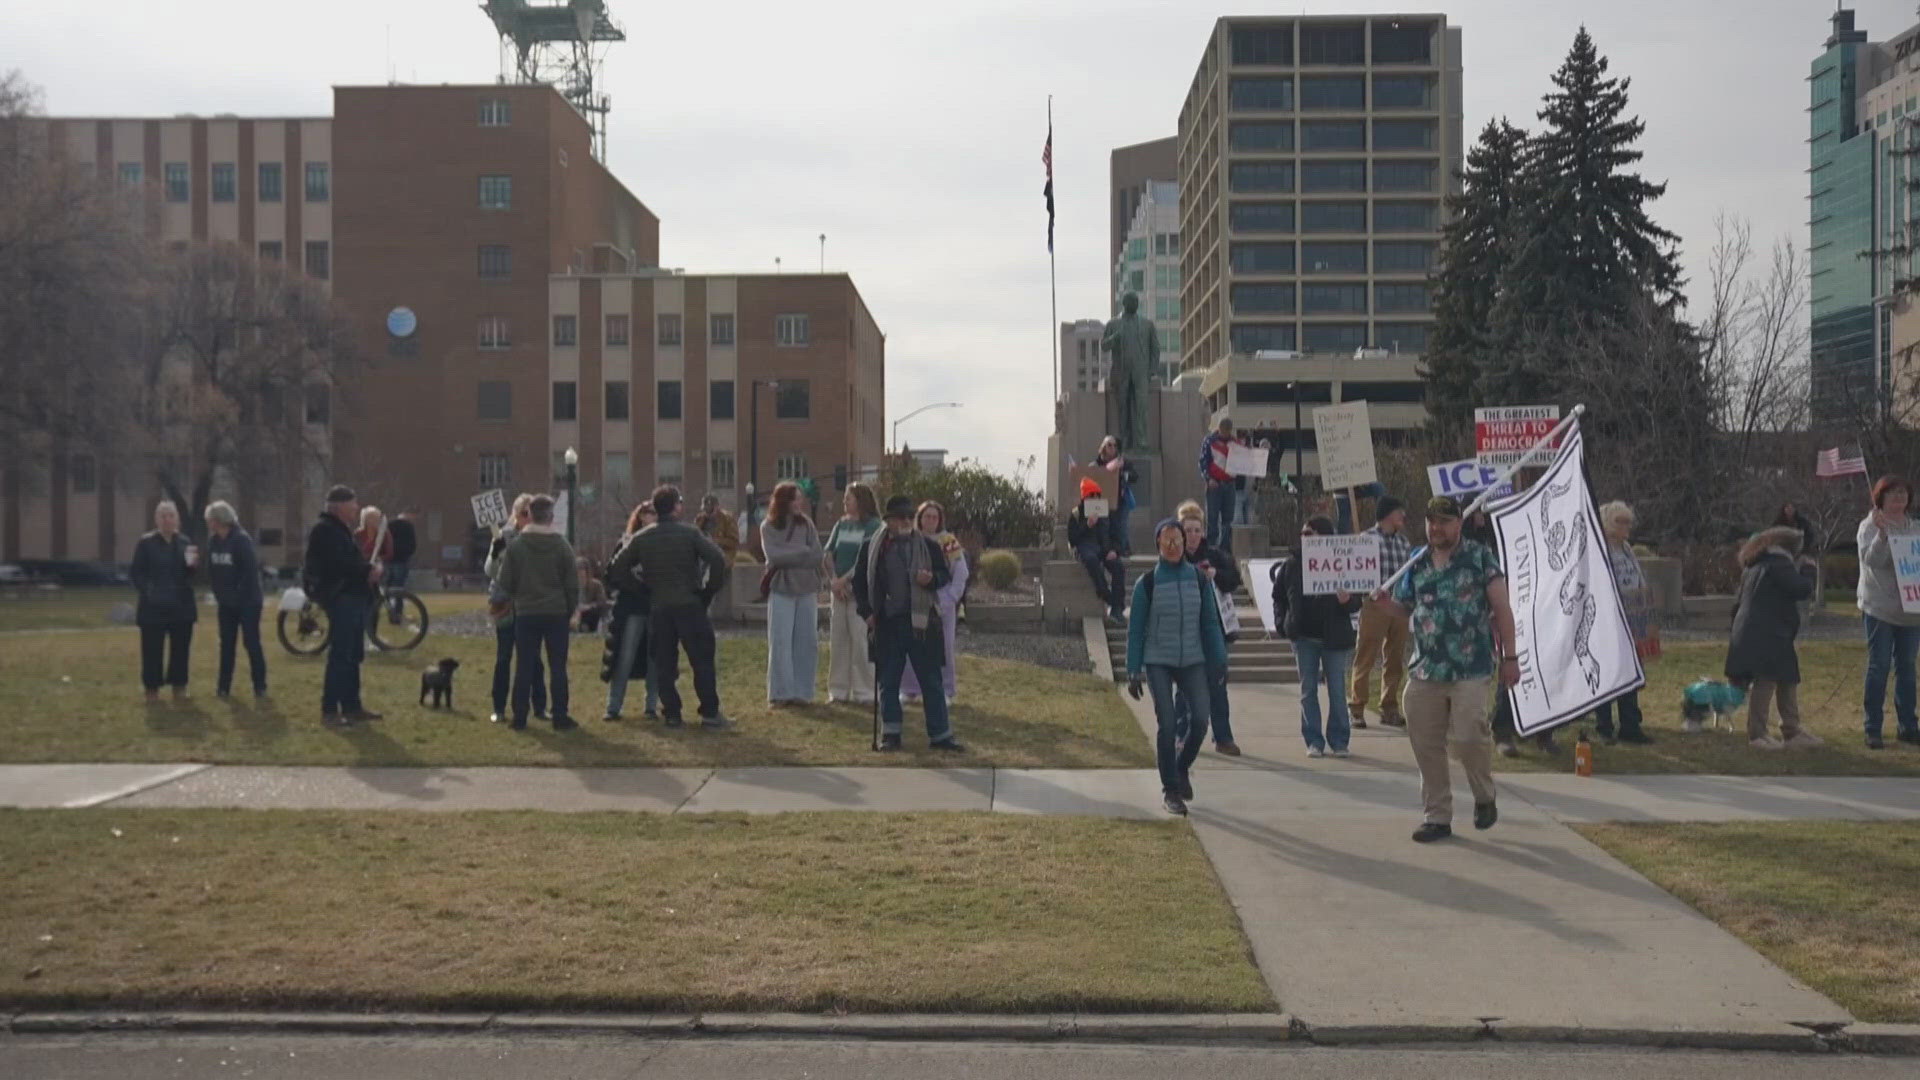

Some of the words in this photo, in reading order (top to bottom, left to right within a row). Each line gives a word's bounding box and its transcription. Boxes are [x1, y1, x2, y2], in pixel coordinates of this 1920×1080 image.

[1483, 409, 1500, 421] THE
[1504, 408, 1551, 420] GREATEST
[1484, 421, 1528, 436] THREAT
[1532, 421, 1548, 434] TO
[1480, 454, 1489, 464] IS
[1437, 462, 1498, 493] ICE
[475, 491, 503, 510] ICE
[479, 507, 504, 525] OUT
[1307, 538, 1323, 547] STOP
[1333, 547, 1353, 557] YOUR
[1308, 556, 1377, 573] RACISM
[1312, 580, 1375, 592] PATRIOTISM
